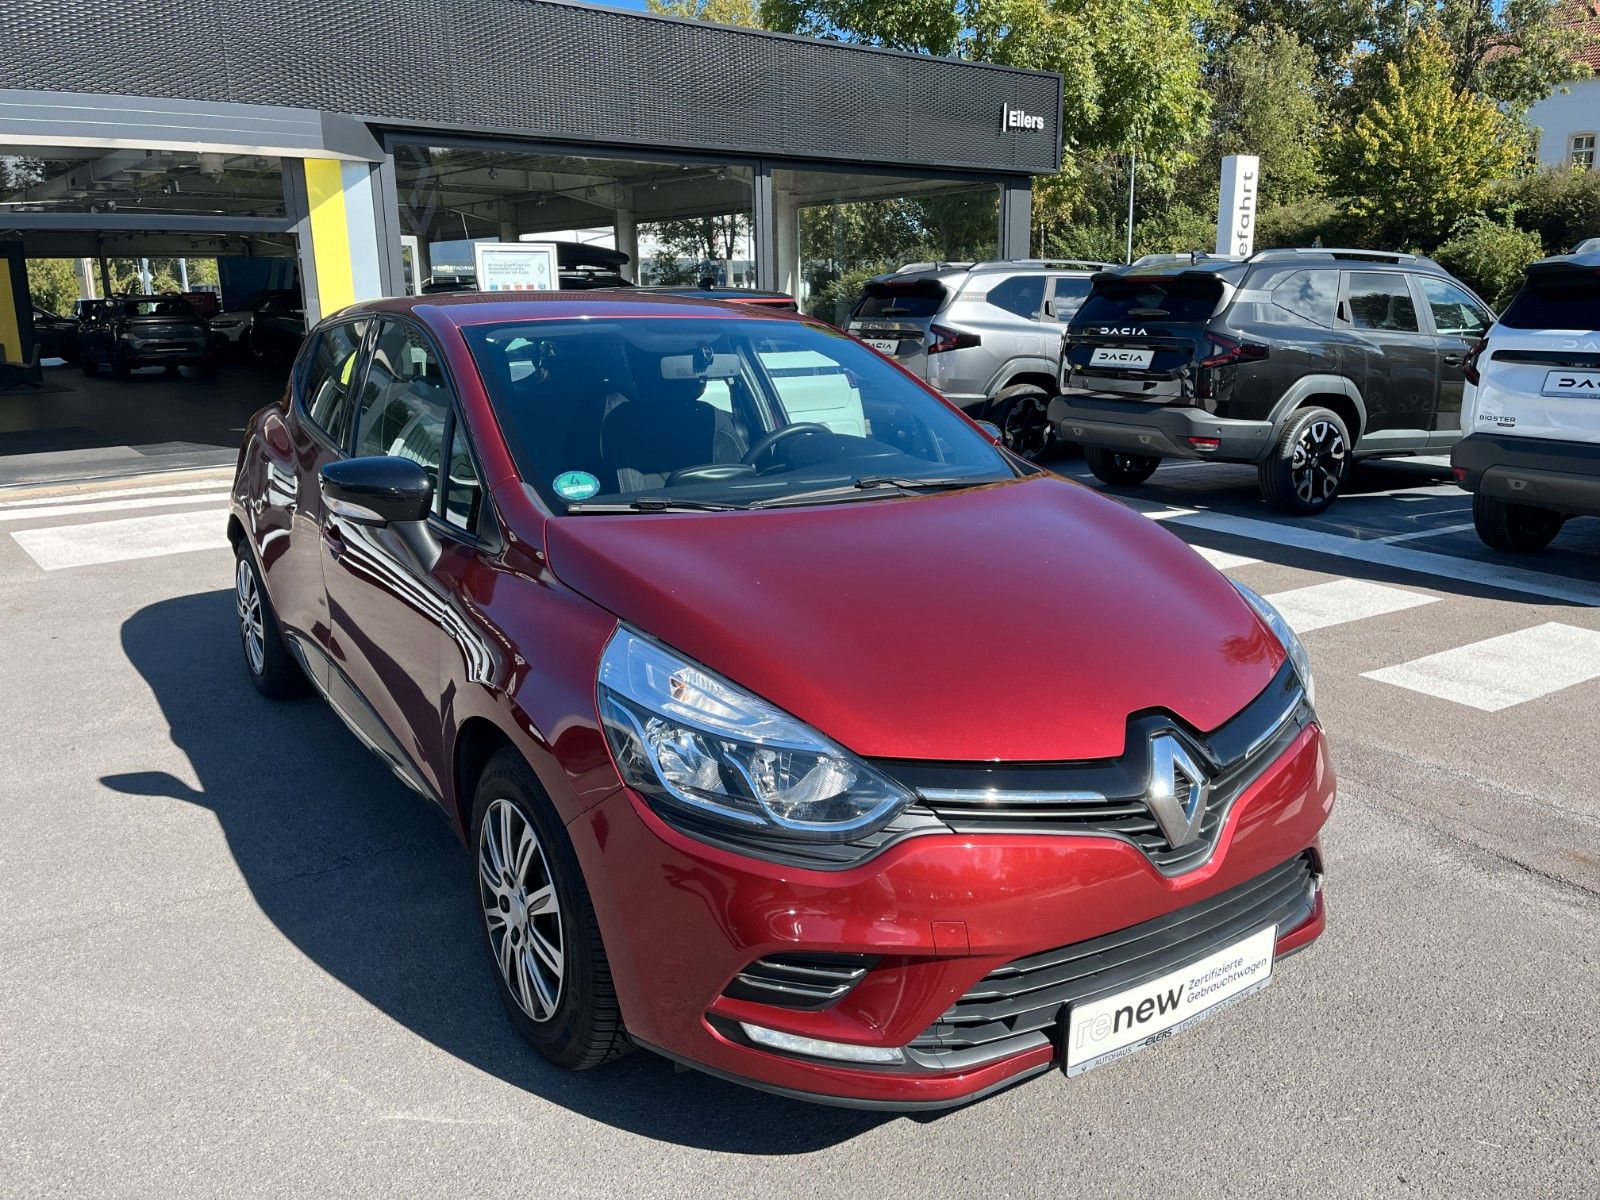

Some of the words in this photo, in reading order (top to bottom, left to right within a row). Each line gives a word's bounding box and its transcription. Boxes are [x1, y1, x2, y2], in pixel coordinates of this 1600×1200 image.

[1008, 110, 1044, 130] Eilers
[1100, 327, 1148, 336] DACIA
[1099, 352, 1143, 362] DACIA
[1558, 378, 1600, 389] DA
[1479, 414, 1516, 423] BIGSTER
[1187, 957, 1267, 1003] Gebrauchtwagen
[1188, 957, 1243, 991] Zertifizierte
[1075, 984, 1184, 1050] renew
[1094, 1047, 1132, 1067] AUTOHAUS
[1143, 1028, 1173, 1046] EILERS
